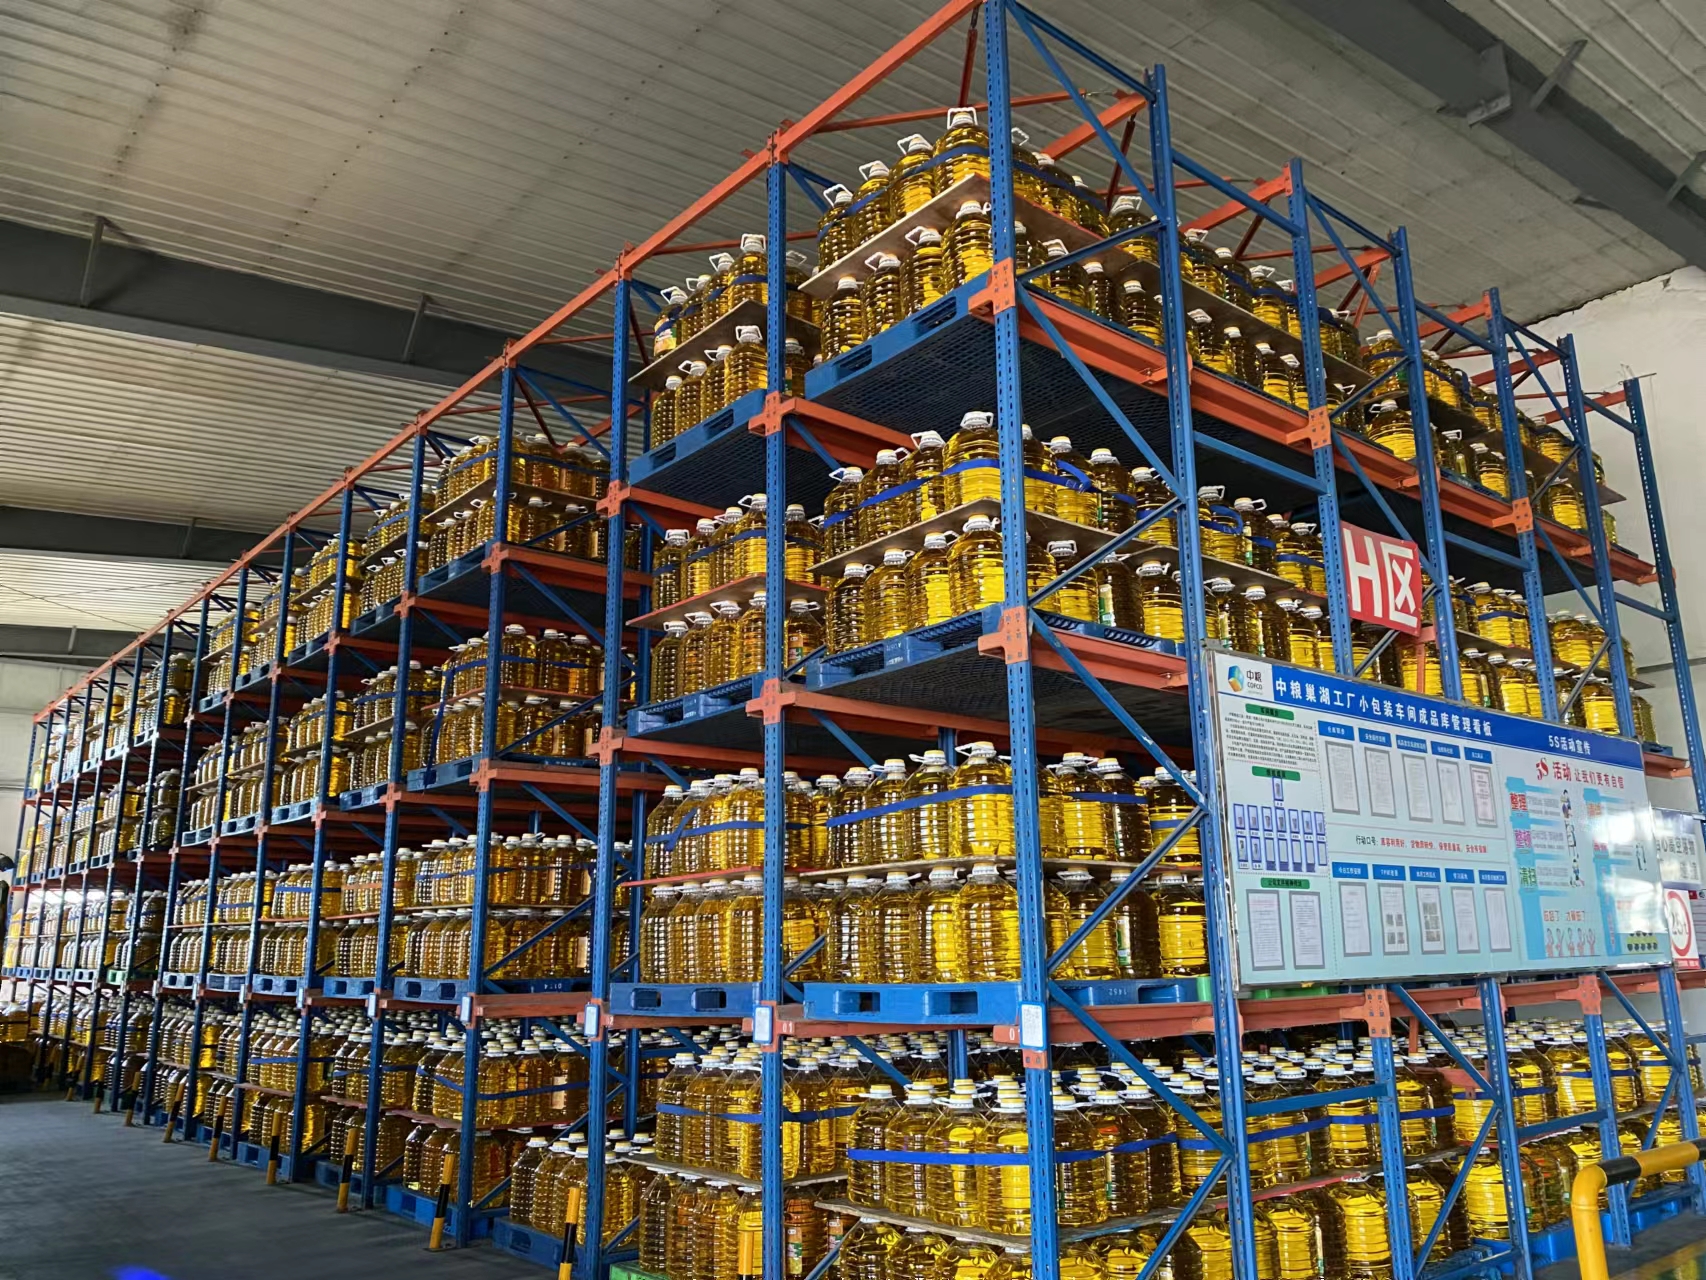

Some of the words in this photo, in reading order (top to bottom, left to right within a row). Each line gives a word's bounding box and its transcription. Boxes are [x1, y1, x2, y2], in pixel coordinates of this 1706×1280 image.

[1342, 527, 1418, 629] H区
[1246, 669, 1262, 682] 中粮
[1247, 681, 1263, 690] COFCO
[1275, 677, 1493, 737] 中粮巢湖工厂小包装车间成品库管理看板
[1548, 735, 1591, 755] 5S活动宣传
[1574, 768, 1625, 789] 让我们更有自信
[1509, 792, 1528, 812] 整理
[1514, 829, 1532, 848] 整顿
[1520, 867, 1537, 887] 清扫
